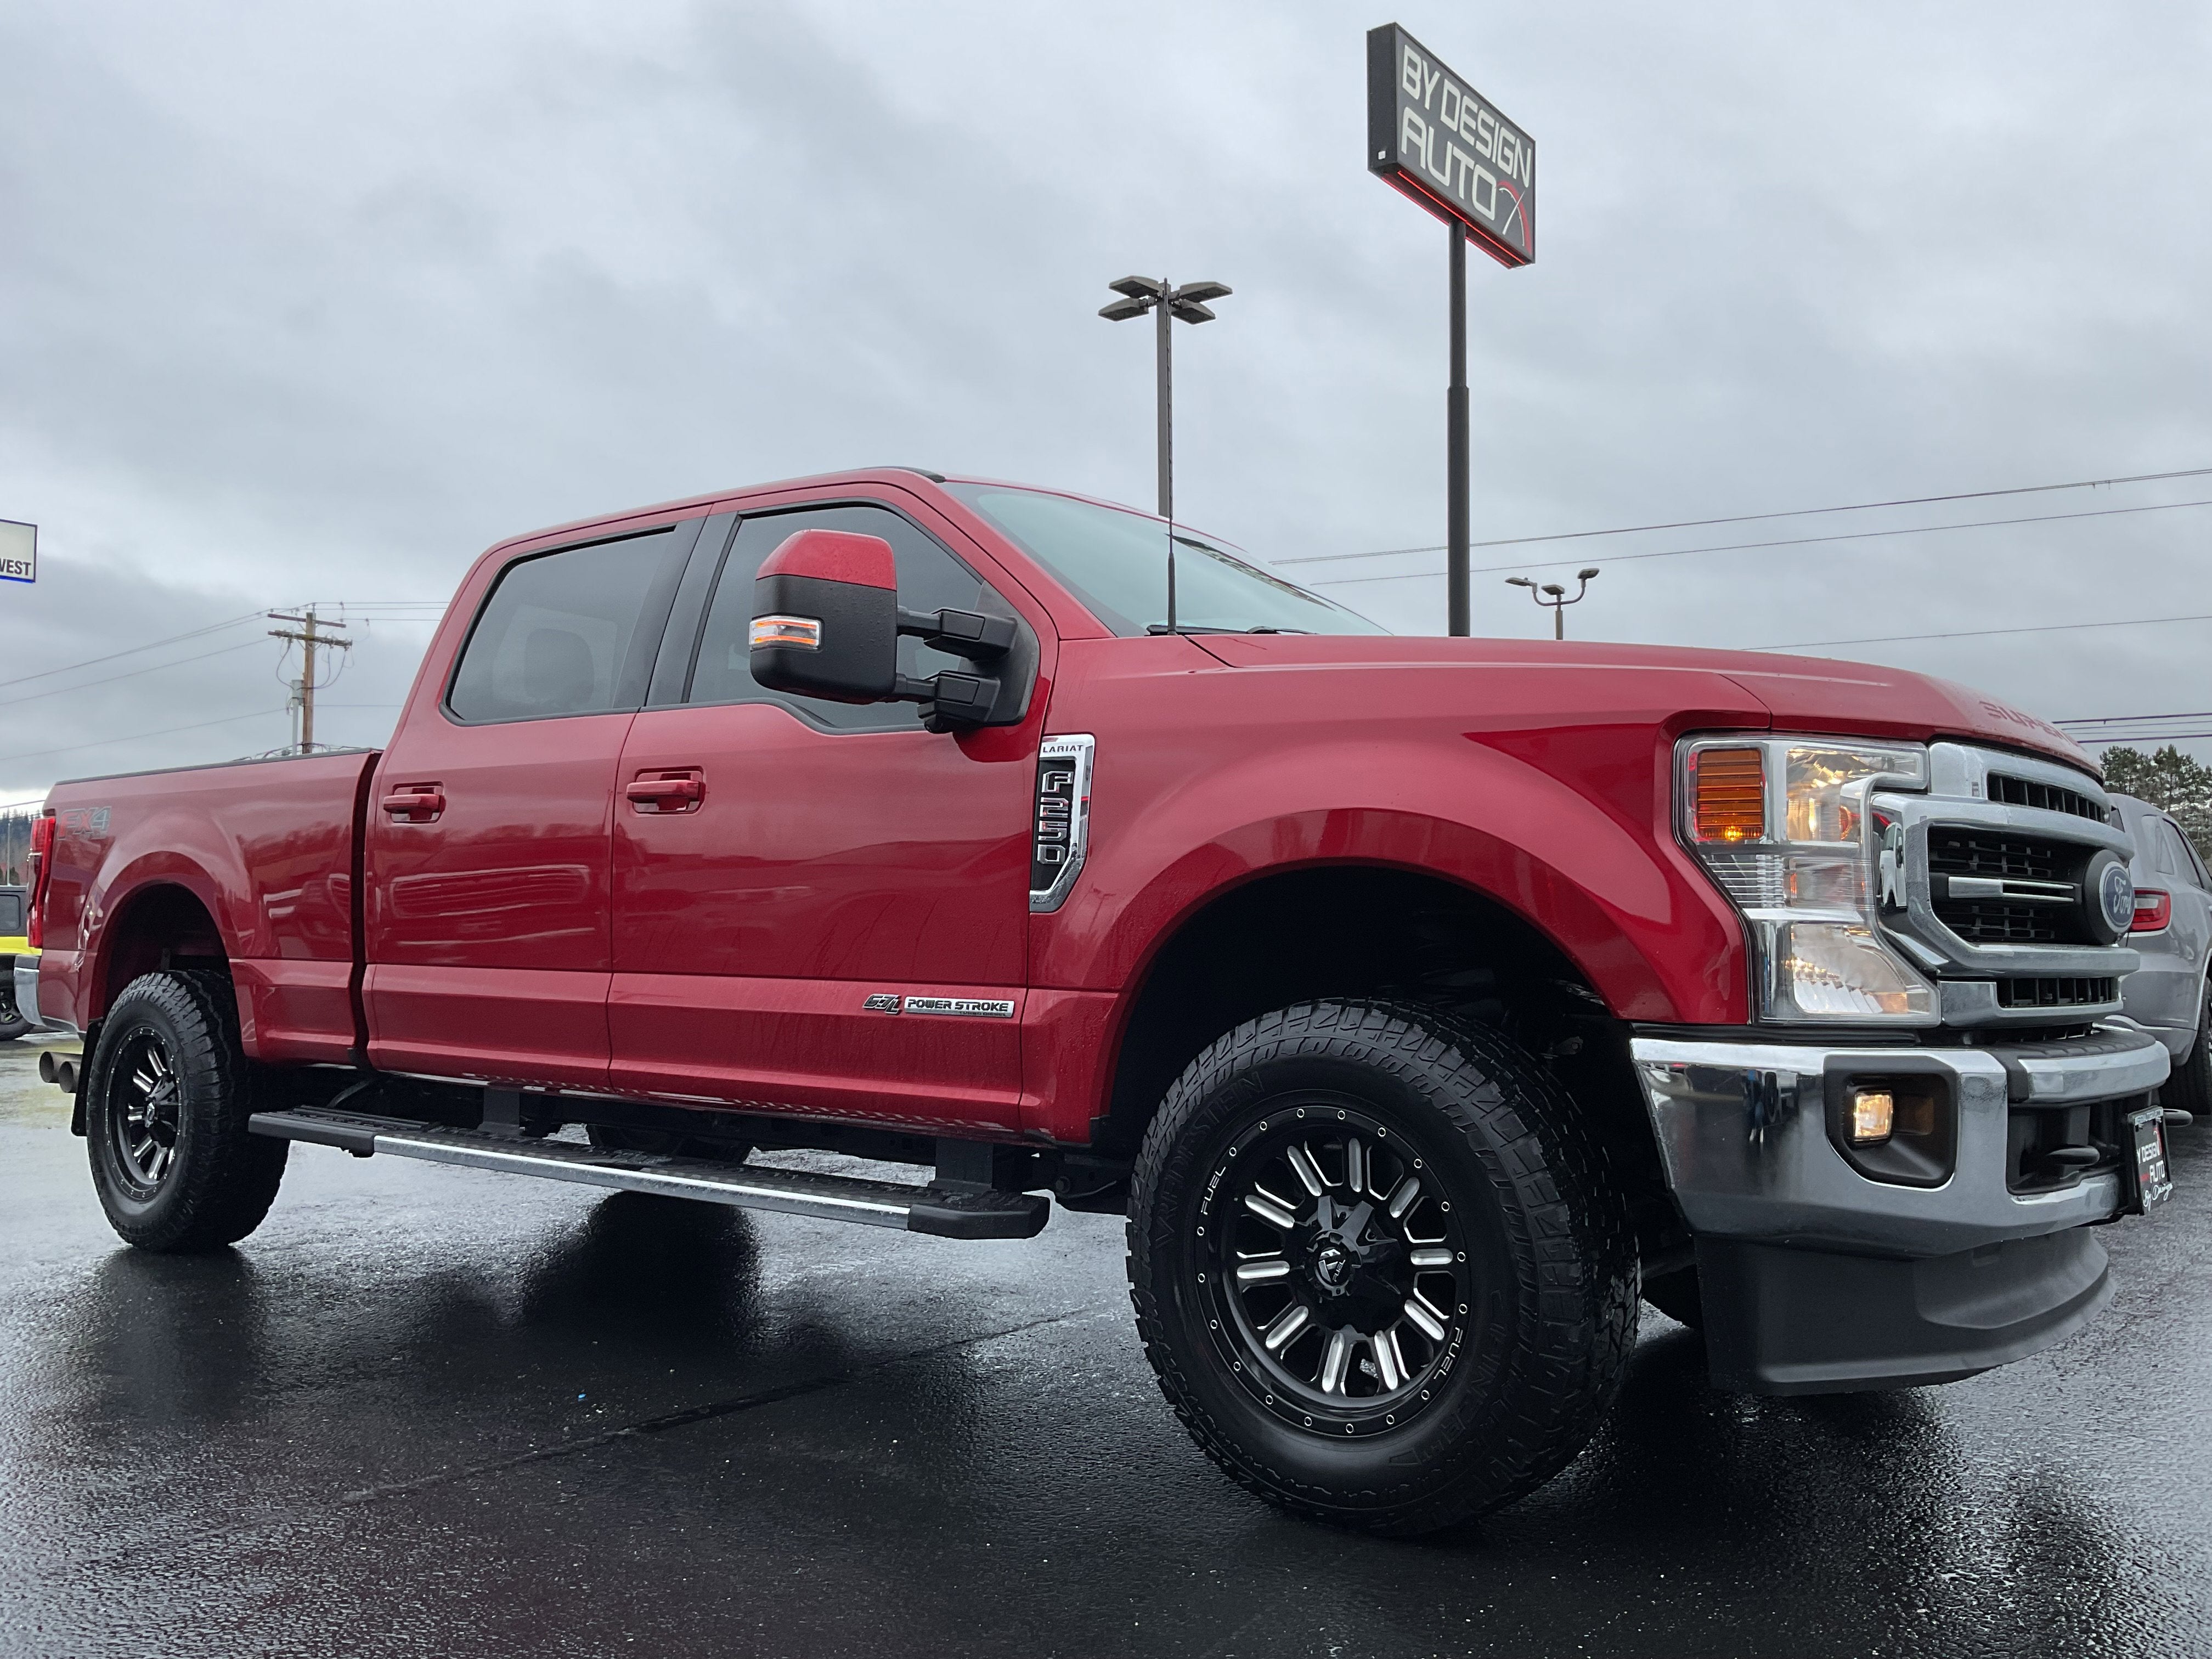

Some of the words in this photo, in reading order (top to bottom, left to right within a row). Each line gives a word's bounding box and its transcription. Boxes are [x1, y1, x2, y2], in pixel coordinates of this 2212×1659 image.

[1402, 44, 1441, 110] BY
[1440, 78, 1532, 188] DESIGN
[1401, 106, 1497, 221] AUTO
[1042, 744, 1084, 753] LARIAT
[58, 806, 111, 840] FX4
[1037, 771, 1074, 865] F250
[2113, 876, 2132, 915] Ford
[908, 998, 952, 1009] POWER
[955, 1001, 1009, 1012] STROKE
[1200, 1166, 1226, 1215] FUEL
[2149, 1160, 2165, 1183] AUTO
[1332, 1259, 1346, 1282] FUEL
[1433, 1327, 1464, 1380] FUEL
